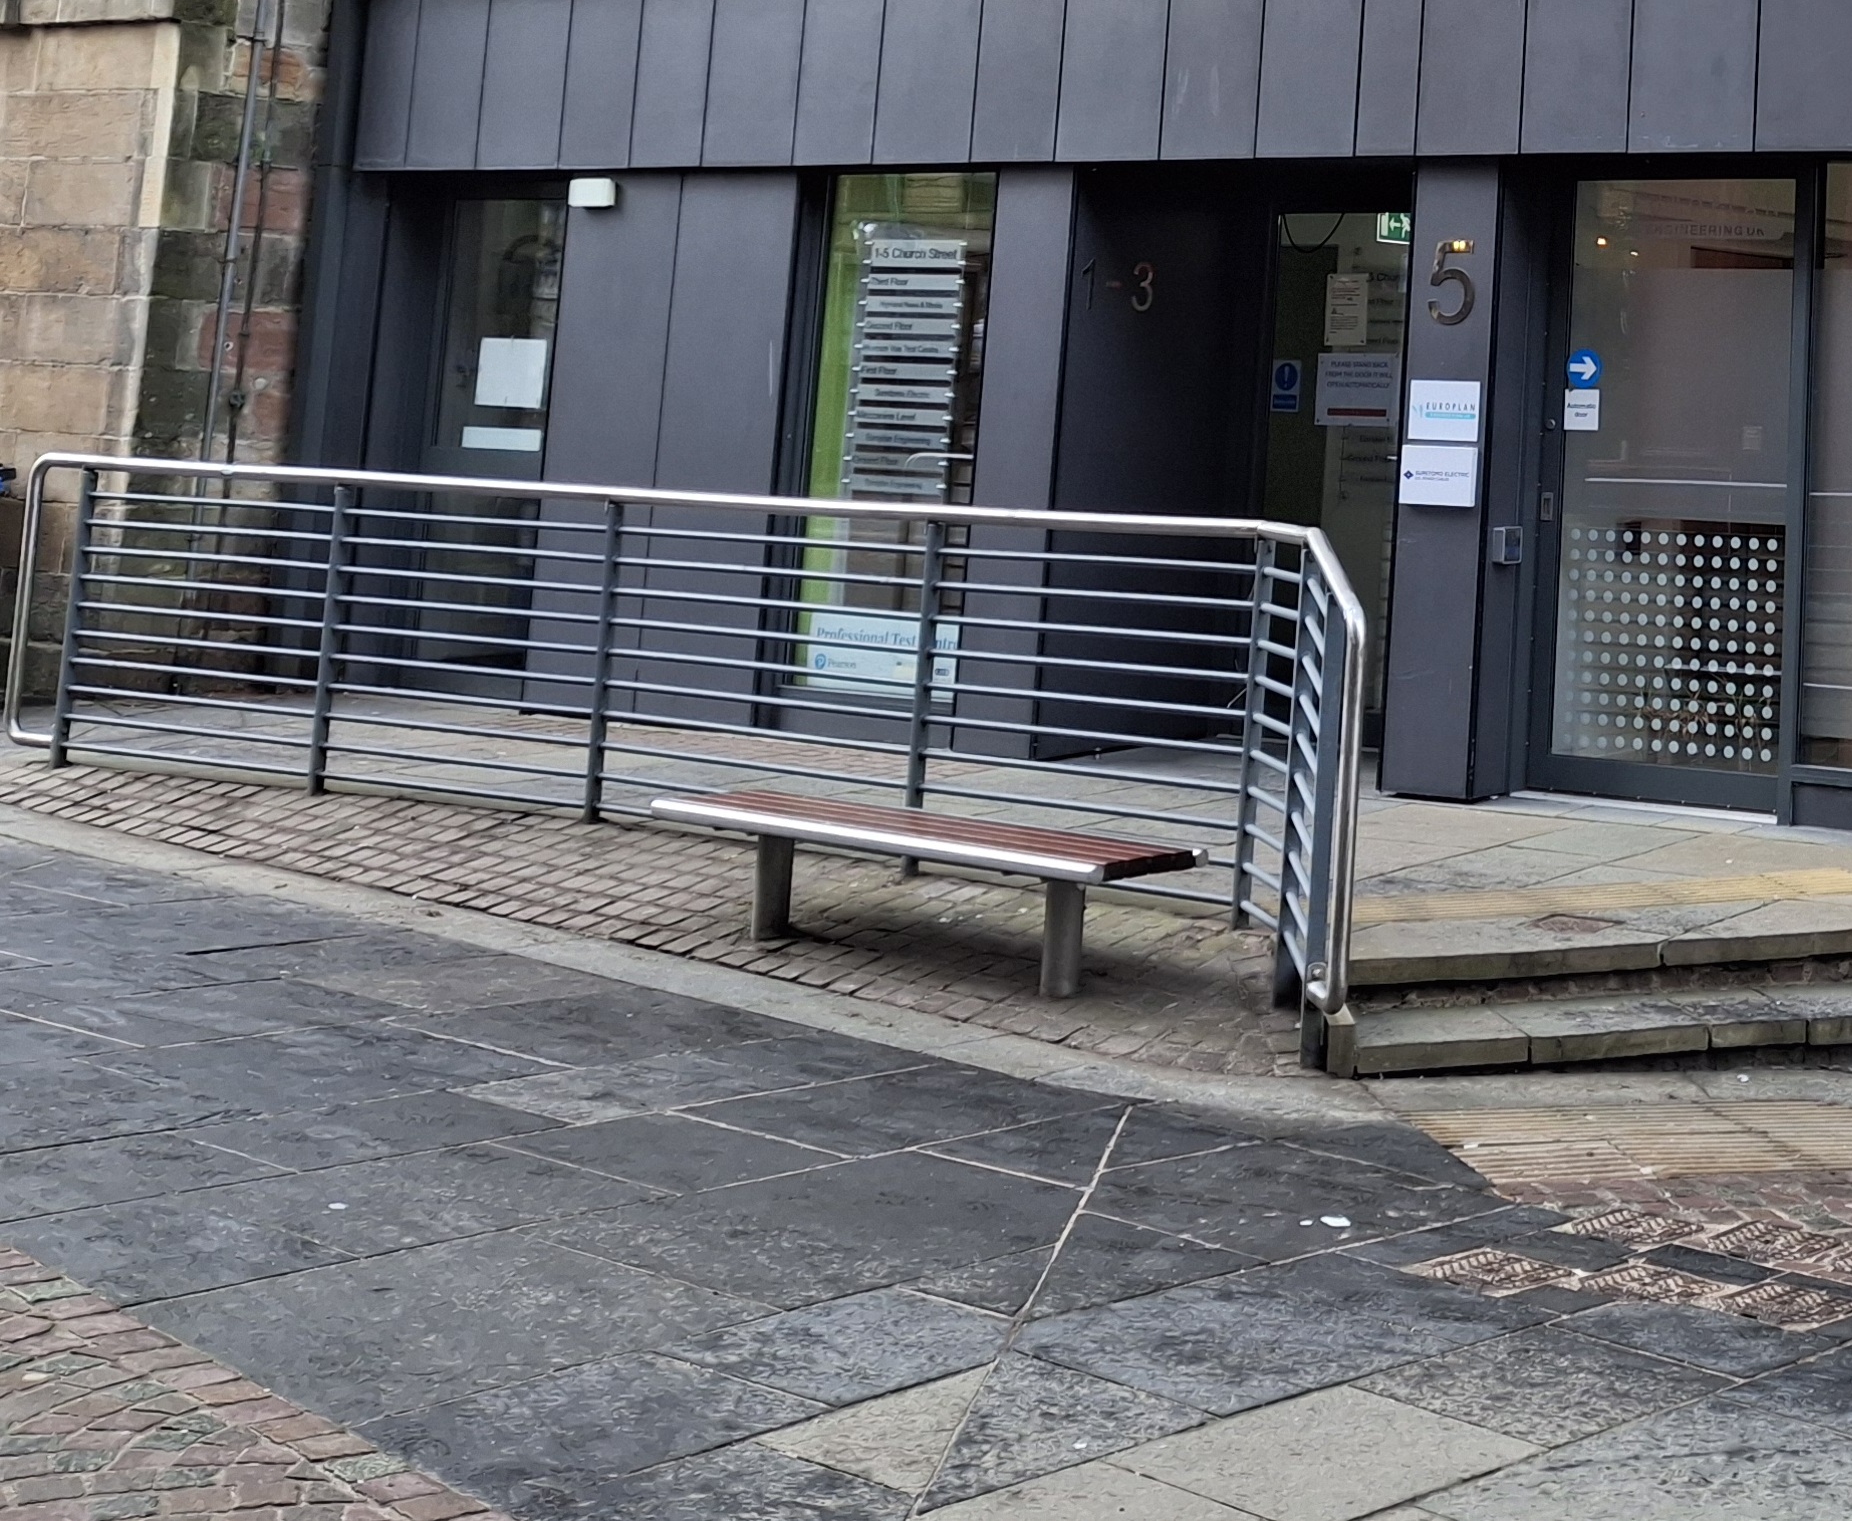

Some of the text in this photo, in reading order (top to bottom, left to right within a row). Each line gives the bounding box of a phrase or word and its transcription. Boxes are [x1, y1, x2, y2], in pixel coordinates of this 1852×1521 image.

[875, 247, 958, 260] 1-5 Church Street
[1427, 239, 1475, 326] 5
[1426, 402, 1476, 412] EUROPLAN
[816, 626, 889, 645] Professional
[891, 632, 916, 647] Test
